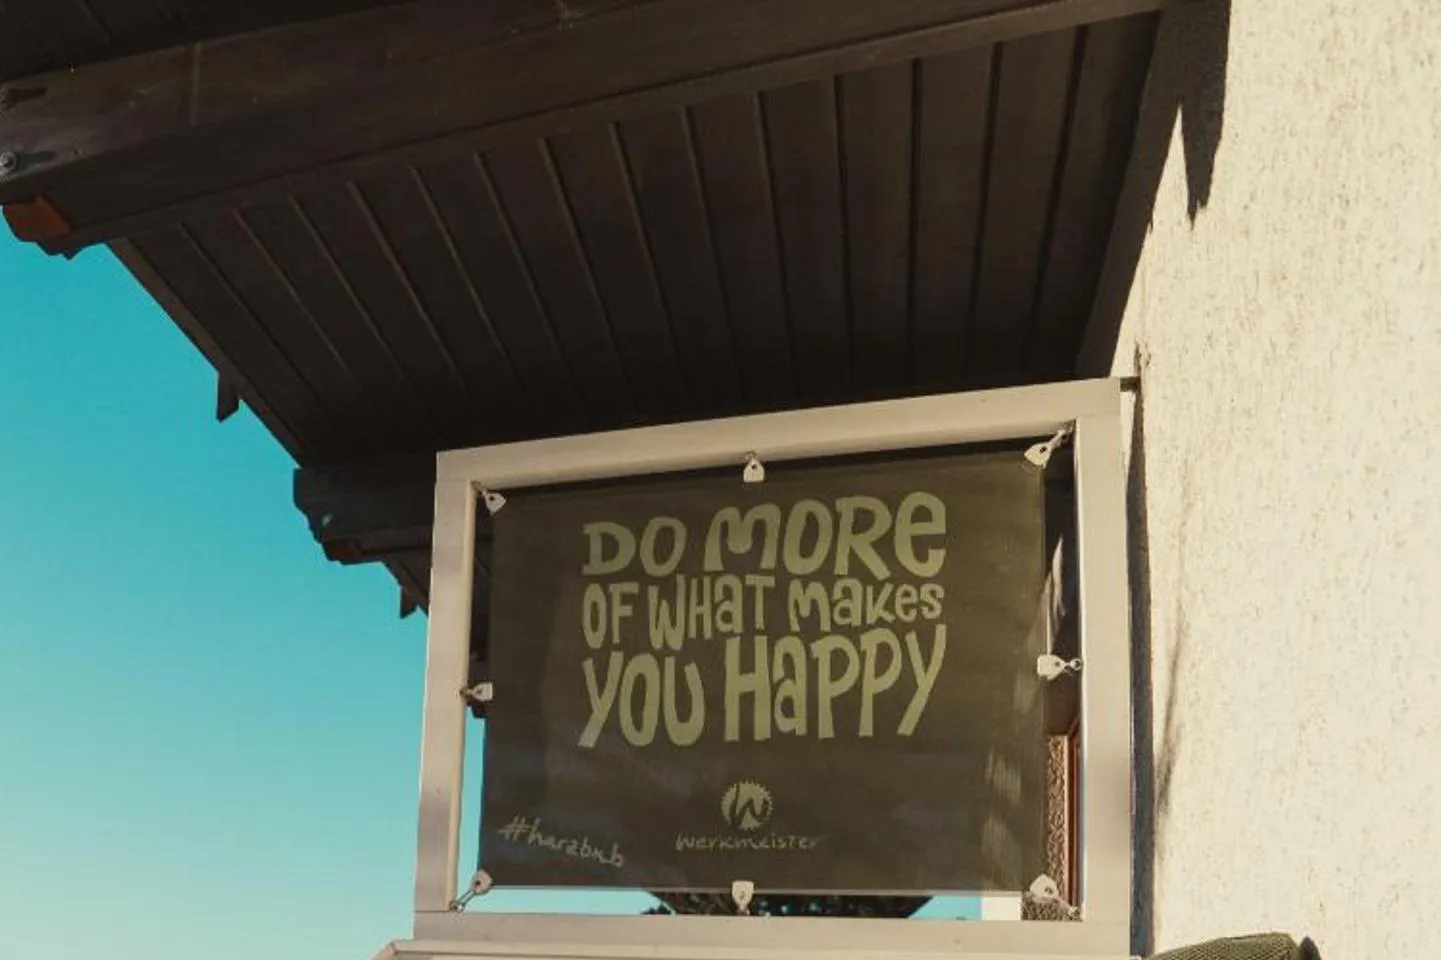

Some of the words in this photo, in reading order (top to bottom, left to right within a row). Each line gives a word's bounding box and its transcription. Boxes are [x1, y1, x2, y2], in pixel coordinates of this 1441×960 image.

[581, 515, 688, 577] DO
[581, 581, 640, 650] OF
[577, 651, 706, 748] YOU
